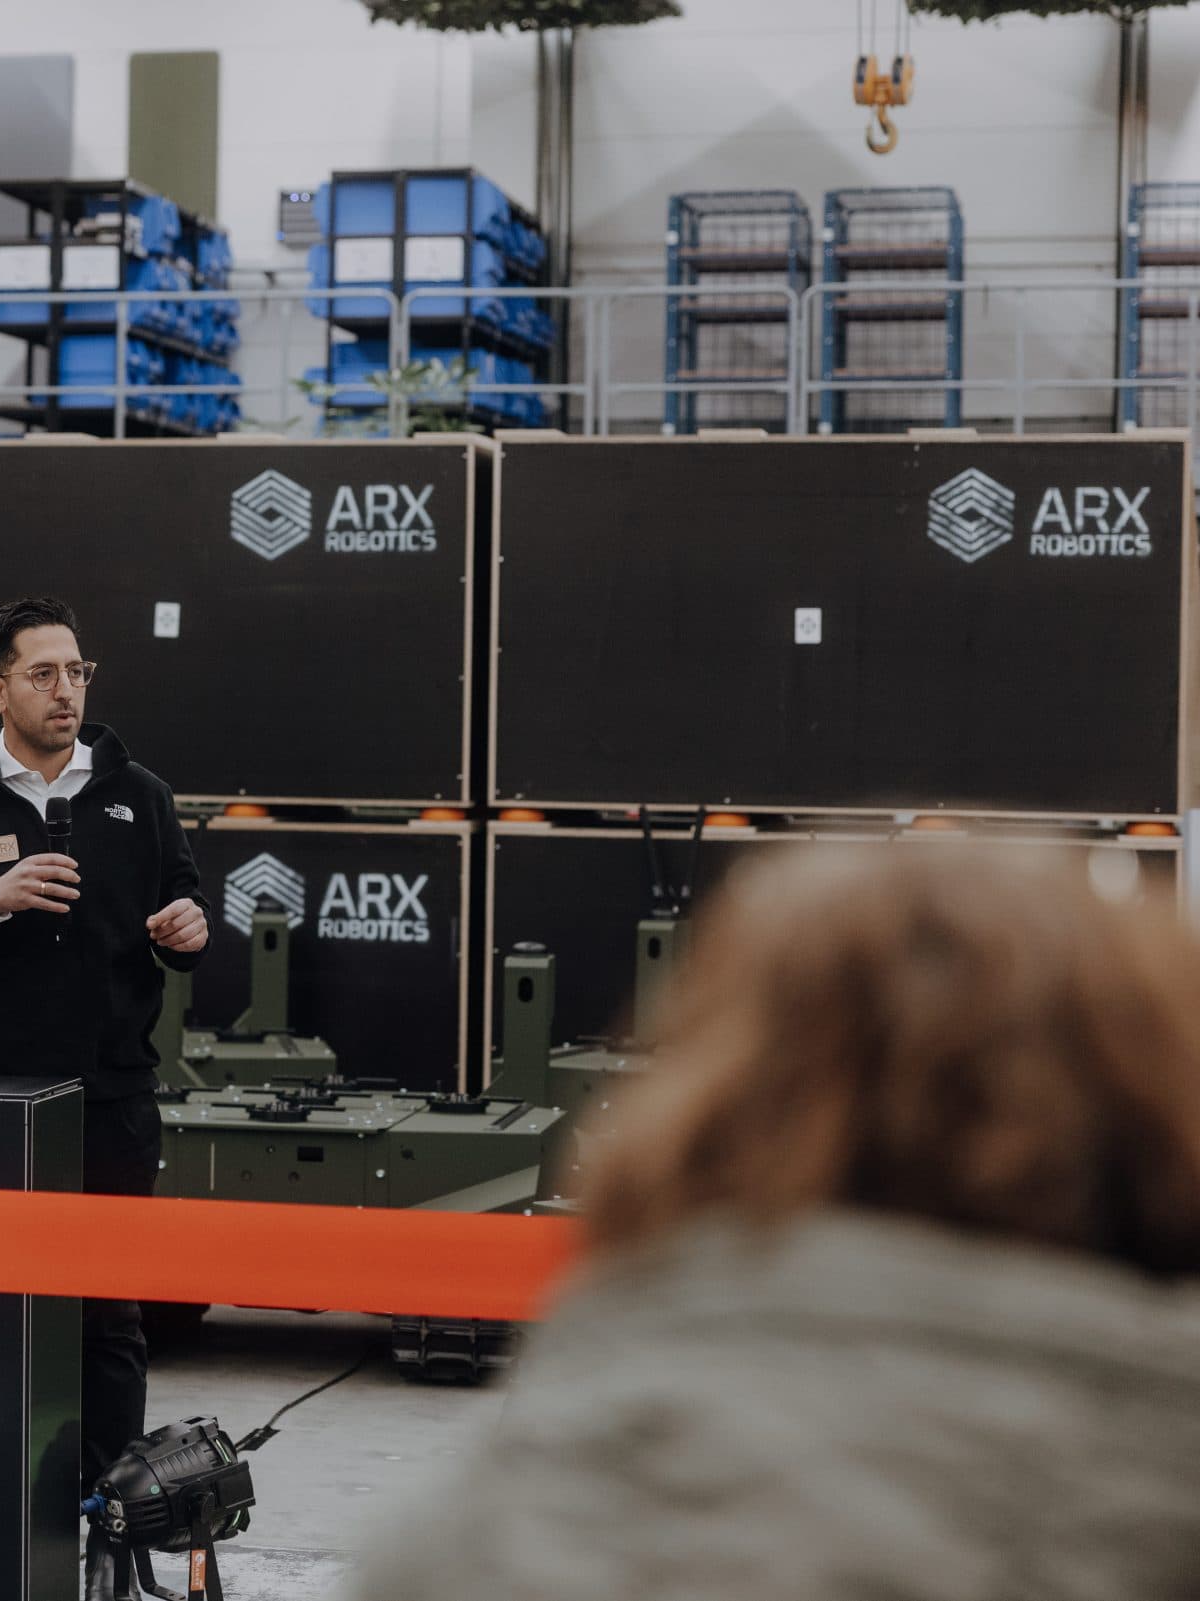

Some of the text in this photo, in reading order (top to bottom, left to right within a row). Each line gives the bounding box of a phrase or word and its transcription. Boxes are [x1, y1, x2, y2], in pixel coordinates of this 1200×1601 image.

[326, 484, 435, 530] ARX
[1031, 486, 1151, 533] ARX
[325, 529, 438, 553] ROBOTICS
[1030, 533, 1152, 556] ROBOTICS
[320, 873, 428, 919] ARX
[318, 918, 429, 942] ROBOTICS
